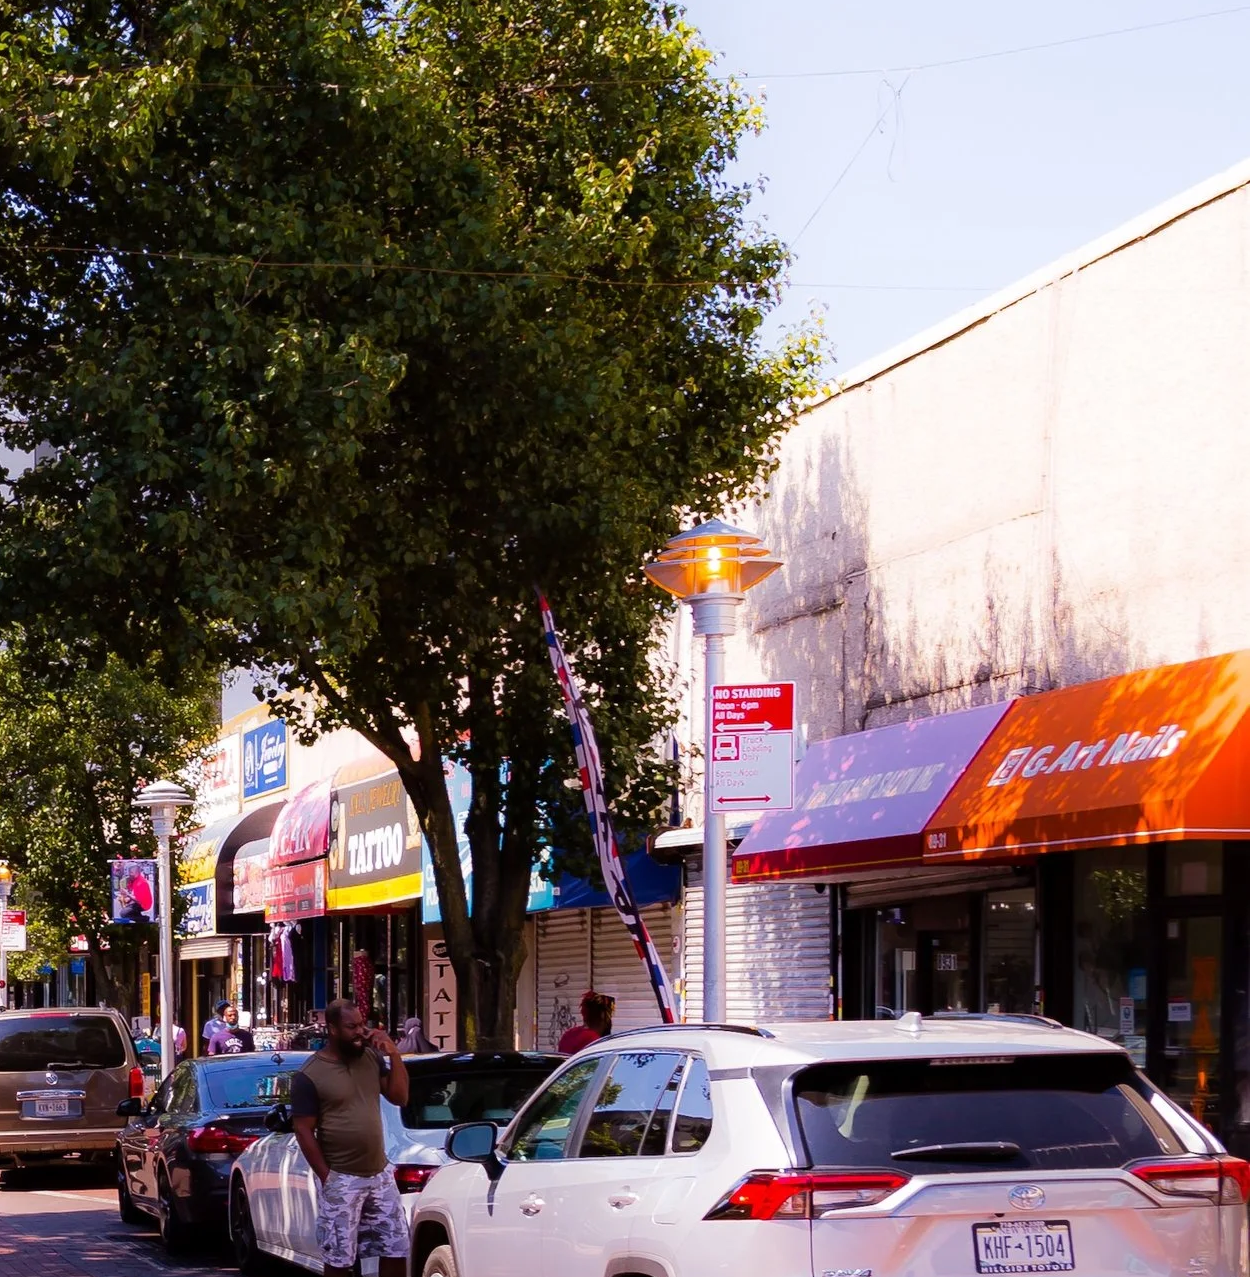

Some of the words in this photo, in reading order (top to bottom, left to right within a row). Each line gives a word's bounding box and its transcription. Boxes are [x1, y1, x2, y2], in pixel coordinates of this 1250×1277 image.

[715, 689, 730, 700] NO
[731, 687, 781, 699] STANDING
[715, 702, 735, 710] Noon
[741, 701, 759, 711] 6pm
[715, 712, 725, 720] All
[726, 711, 745, 720] Days
[742, 736, 764, 744] Truck
[742, 745, 772, 755] Loading
[1099, 724, 1187, 767] Nails
[742, 754, 760, 762] Only
[716, 770, 732, 778] 6pm
[739, 769, 758, 777] Noon
[716, 779, 726, 787] All
[726, 779, 745, 787] Days
[347, 822, 403, 876] TATTOO
[981, 1263, 1030, 1274] HILLSIDE
[1032, 1262, 1073, 1273] TOYOTA
